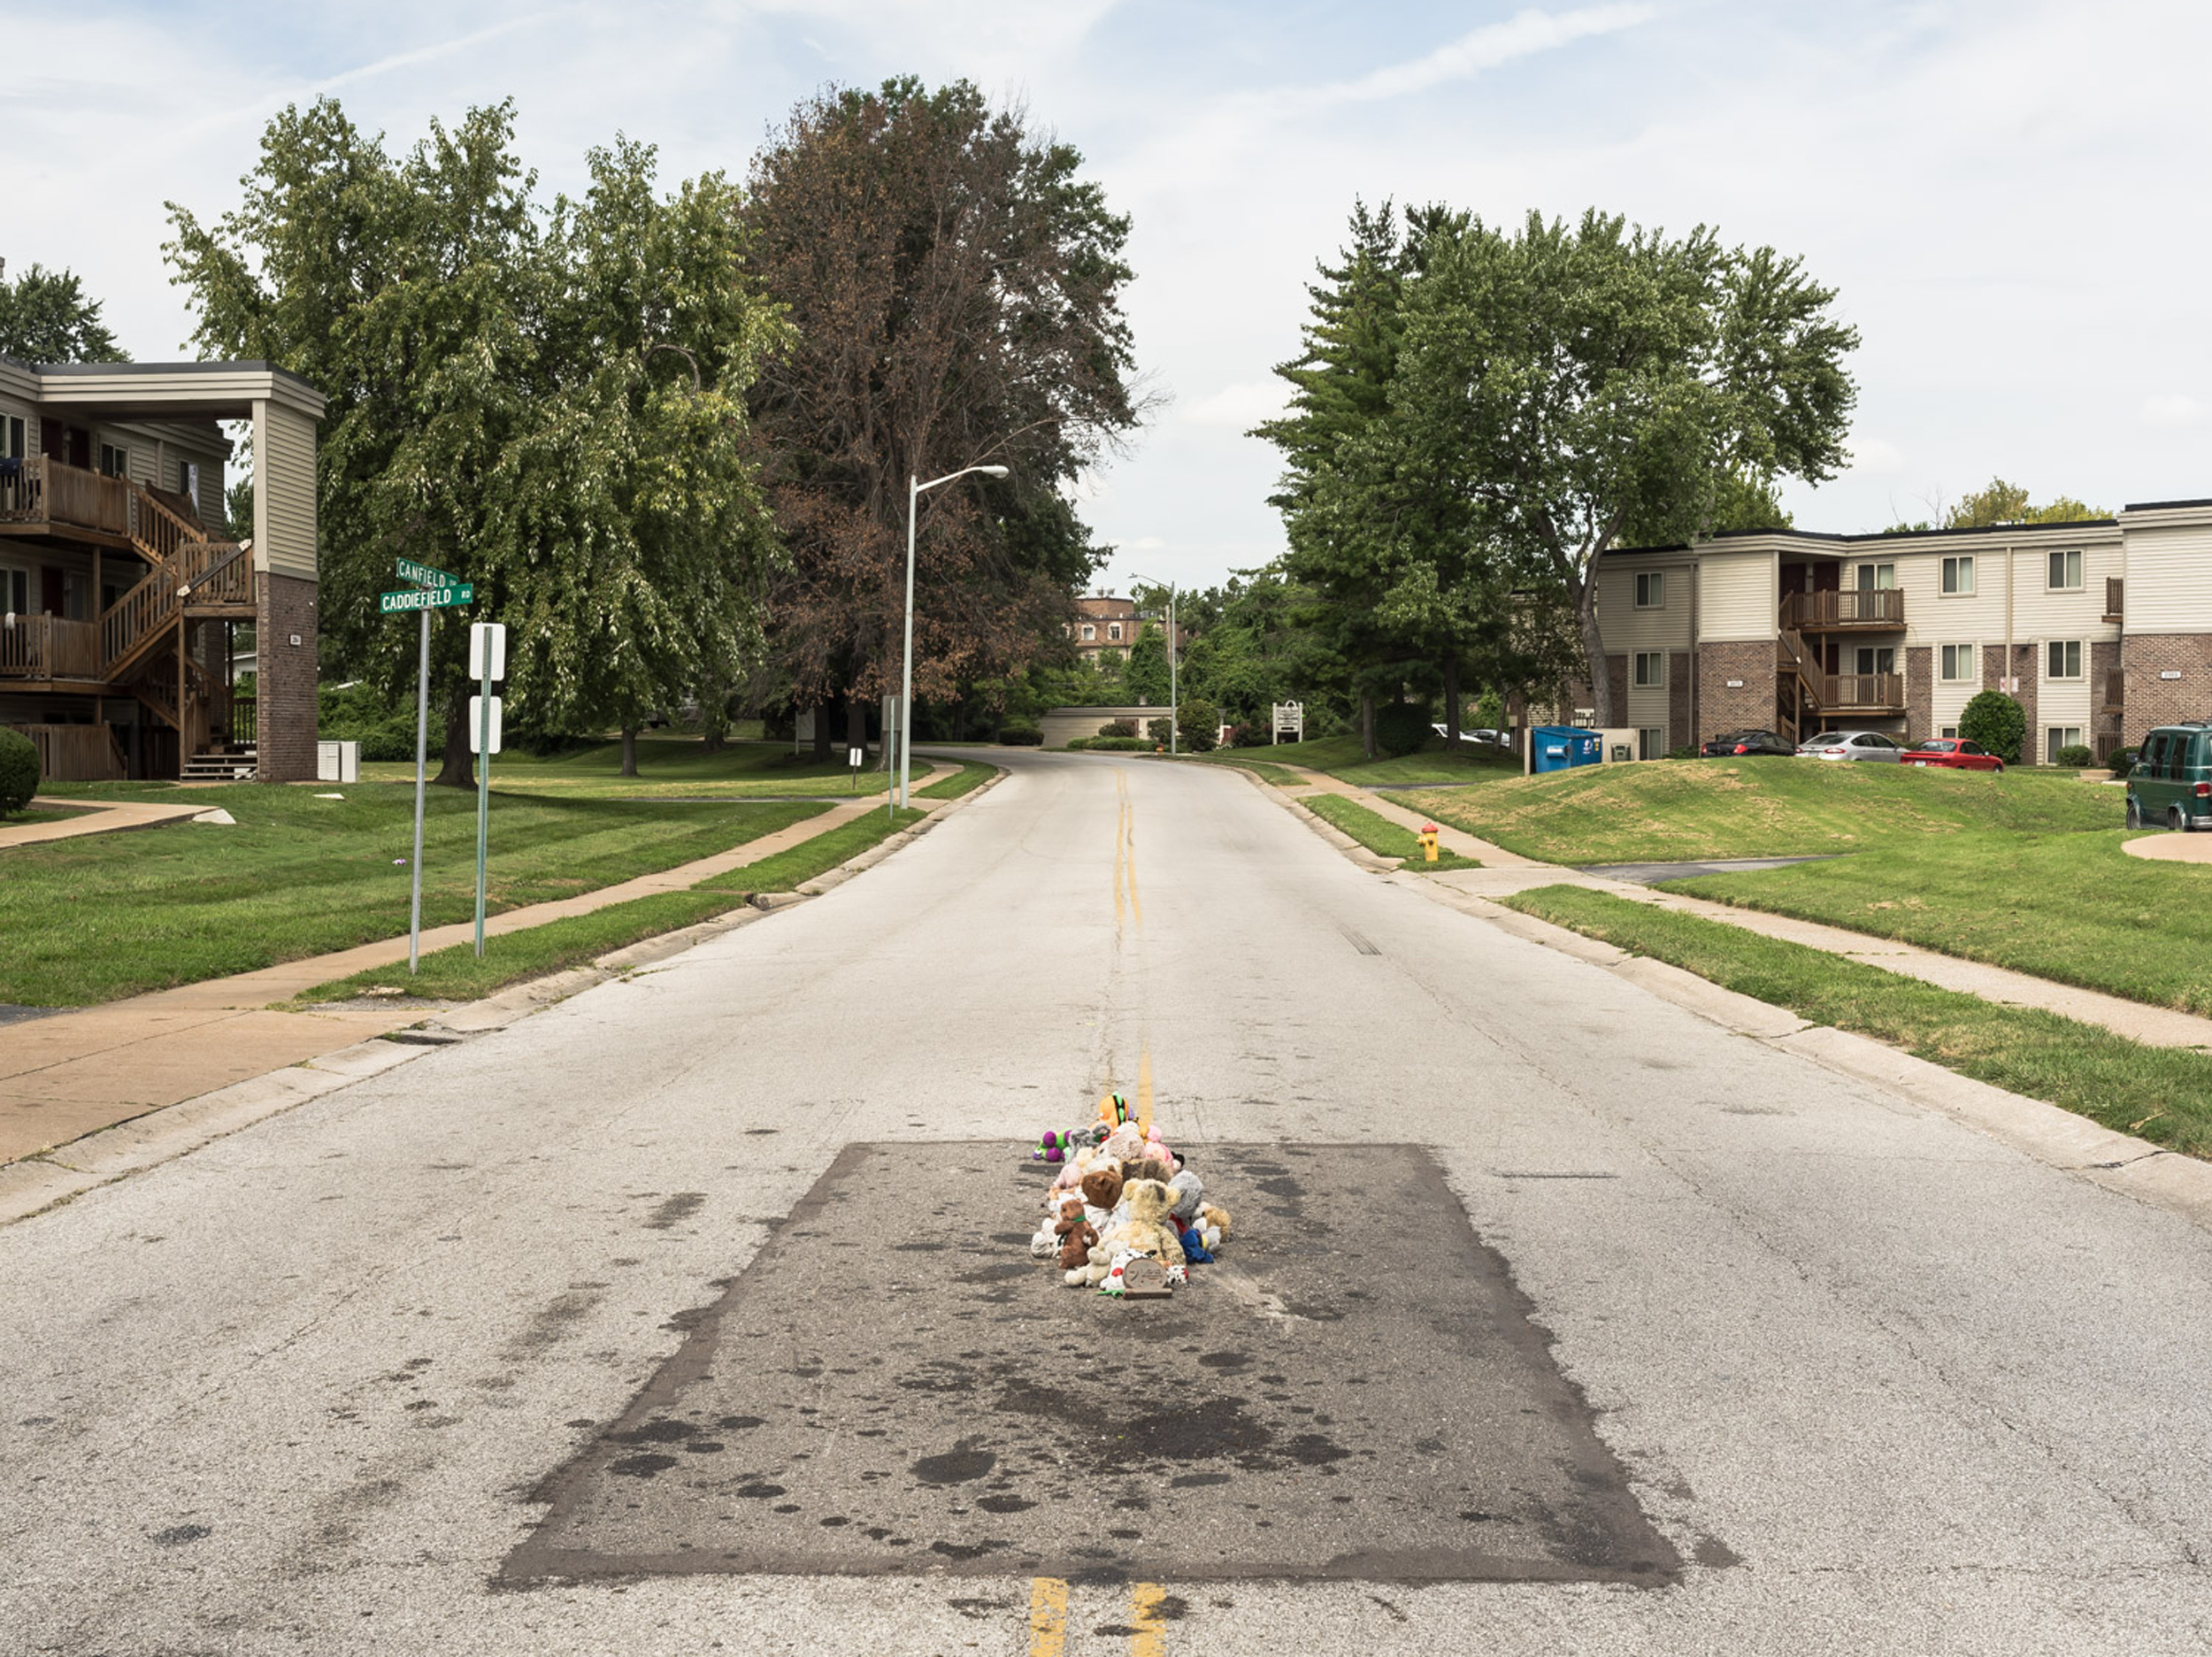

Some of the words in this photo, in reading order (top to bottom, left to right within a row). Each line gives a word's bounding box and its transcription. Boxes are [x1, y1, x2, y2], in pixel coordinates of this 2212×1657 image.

[399, 561, 446, 587] CANFIELD
[382, 589, 451, 610] CADDIEFIELD
[461, 590, 471, 599] RD
